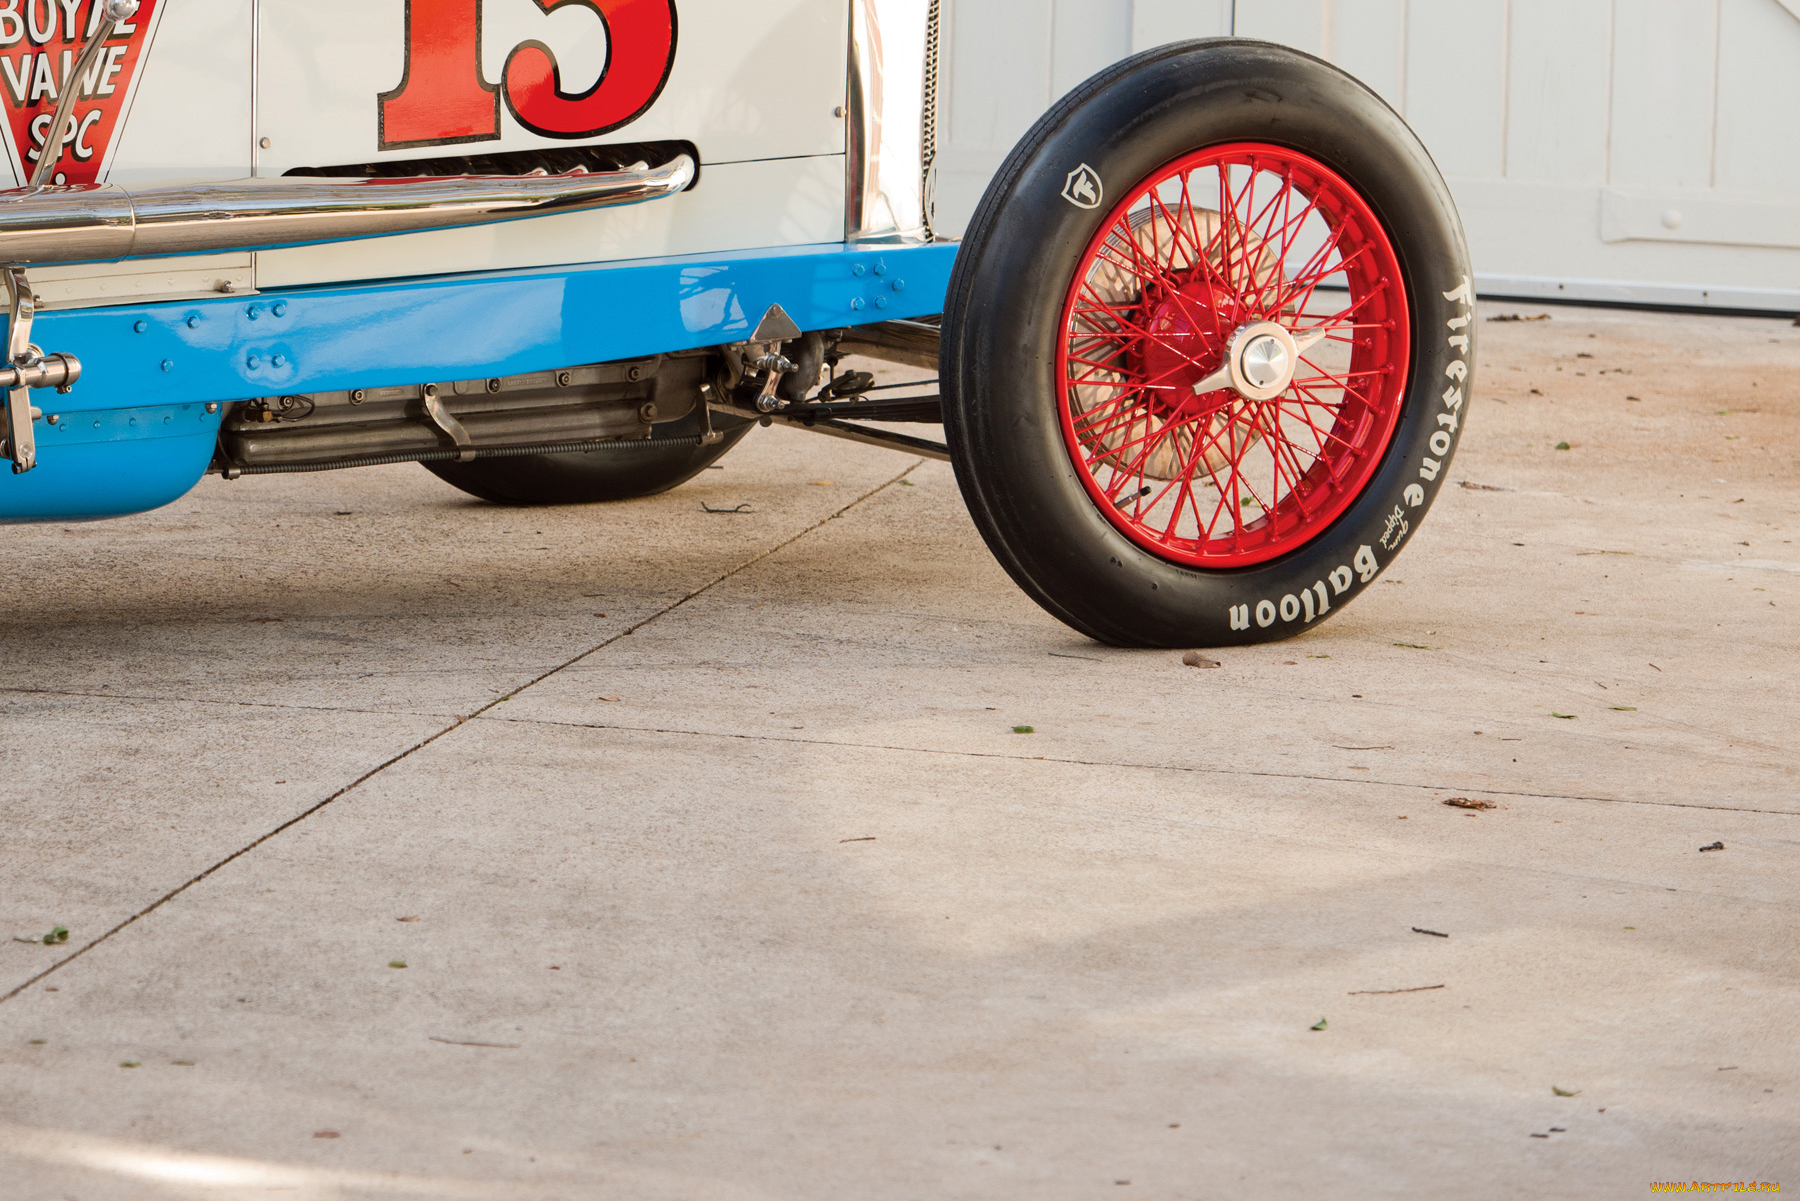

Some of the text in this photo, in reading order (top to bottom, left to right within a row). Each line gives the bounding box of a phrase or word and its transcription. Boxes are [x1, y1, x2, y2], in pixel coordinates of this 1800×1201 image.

[24, 108, 103, 165] SPC
[1403, 275, 1474, 508] Firestone
[1379, 504, 1405, 549] Dipped
[1229, 544, 1380, 632] Balloon
